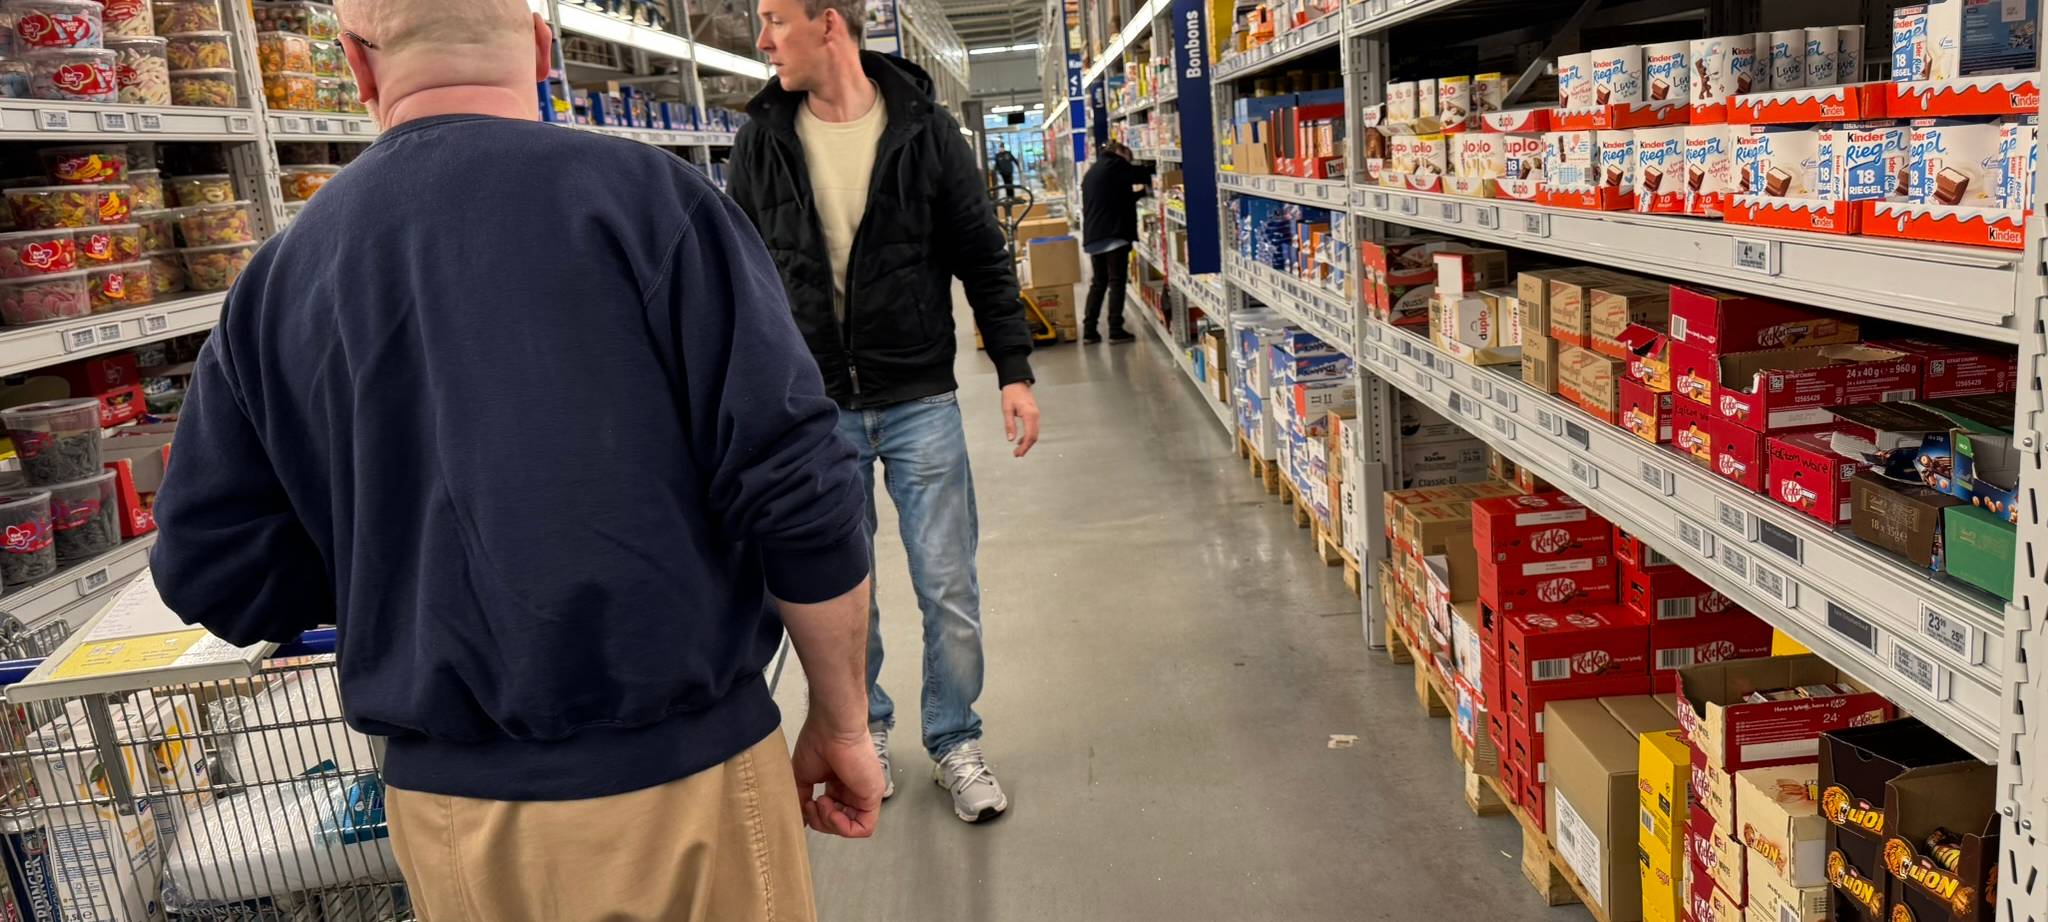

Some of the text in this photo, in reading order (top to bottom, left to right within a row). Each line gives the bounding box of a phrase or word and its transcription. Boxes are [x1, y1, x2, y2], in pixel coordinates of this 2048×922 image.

[1186, 10, 1202, 79] Bonbons
[1646, 53, 1688, 79] Riegel
[1647, 54, 1673, 63] Kinder
[1895, 53, 1906, 67] 18
[1776, 64, 1801, 79] Love
[1809, 61, 1833, 76] Love
[1893, 69, 1912, 77] EGEL
[1613, 78, 1637, 94] Love
[1821, 105, 1844, 116] Kinder
[1737, 136, 1761, 145] Kinder
[1847, 132, 1884, 142] Kinder
[1602, 141, 1626, 149] Kinder
[1640, 141, 1665, 149] Kinder
[1640, 140, 1682, 165] Riegel
[1846, 130, 1908, 167] Riegel
[1602, 145, 1634, 165] Riege
[1507, 159, 1519, 174] 18
[1857, 168, 1875, 185] 18
[1849, 184, 1884, 194] RIEGEL
[1660, 195, 1671, 203] 10
[1811, 214, 1834, 228] Kinder
[1989, 227, 2020, 243] Kinder
[1479, 310, 1489, 345] duplo
[1846, 368, 1857, 378] 24
[1863, 368, 1873, 377] 40
[1874, 369, 1880, 378] g
[1895, 365, 1911, 374] 960
[1911, 365, 1917, 374] g
[1870, 517, 1879, 529] 18
[1531, 529, 1570, 554] KitKat
[1537, 577, 1577, 603] KitKat
[1696, 640, 1736, 664] KitKat
[1572, 650, 1610, 675] KitKat
[1755, 839, 1780, 863] LION
[1843, 874, 1875, 905] LION
[1908, 864, 1960, 900] LION
